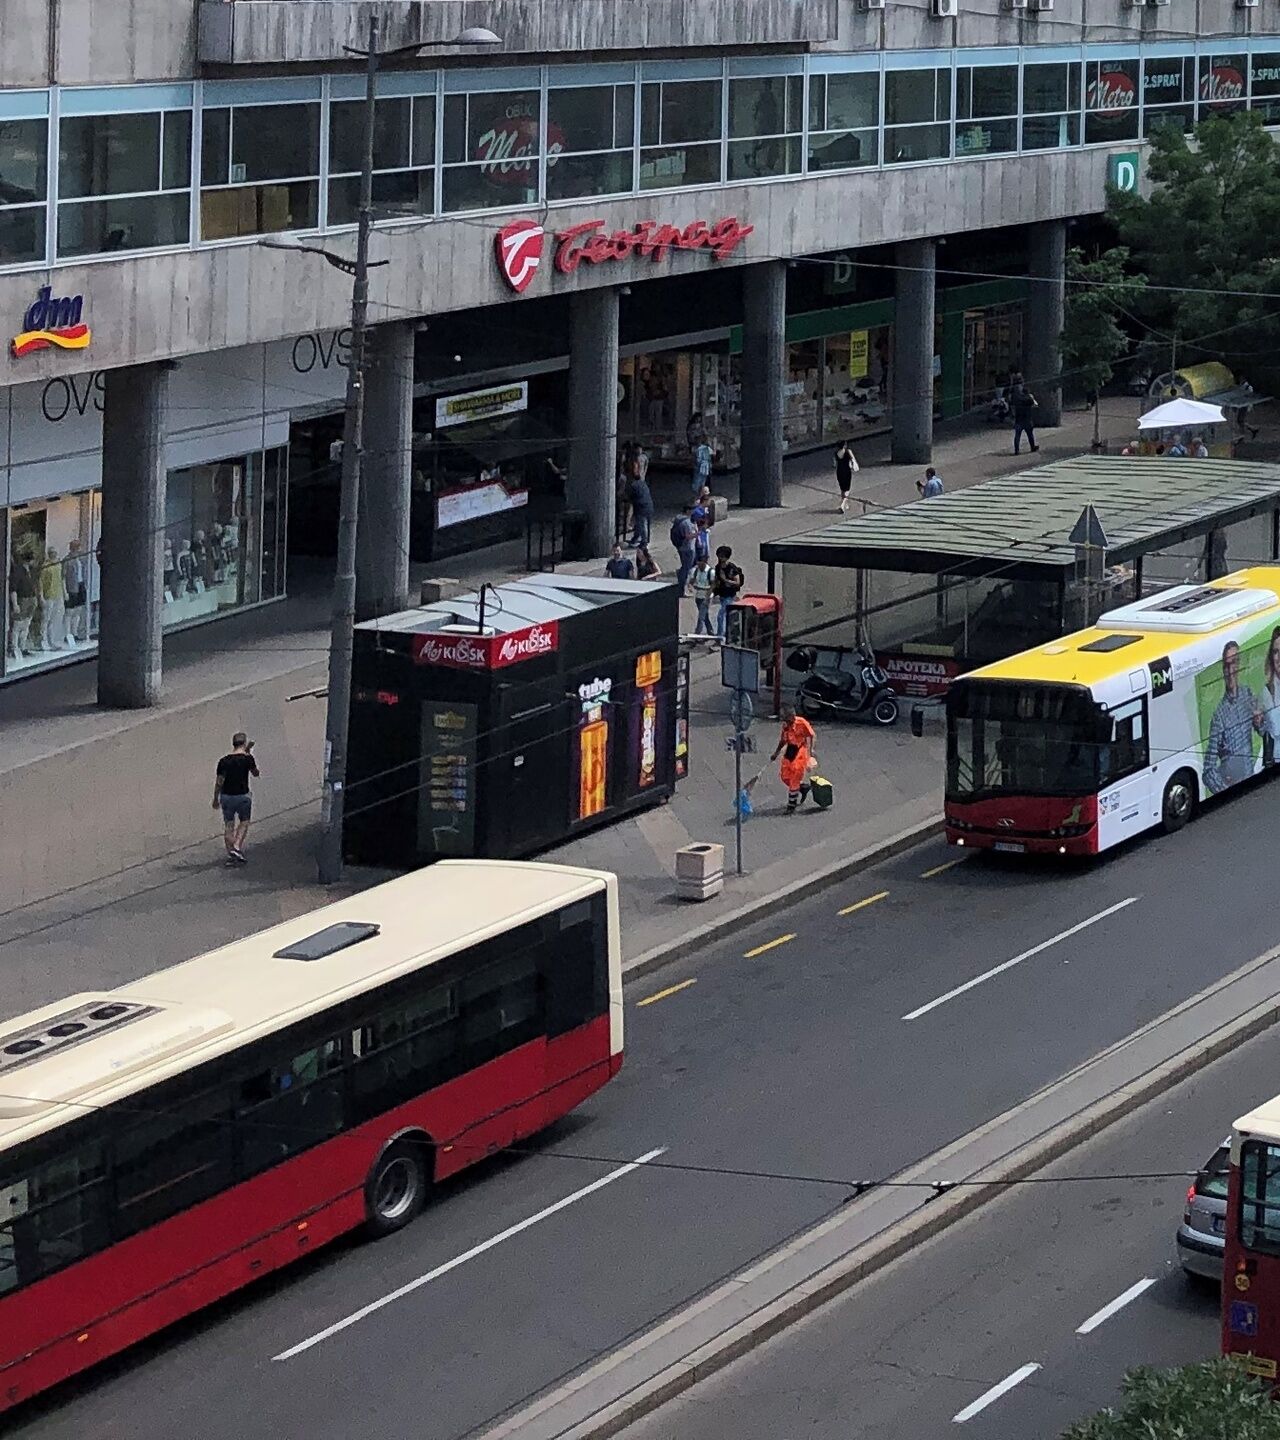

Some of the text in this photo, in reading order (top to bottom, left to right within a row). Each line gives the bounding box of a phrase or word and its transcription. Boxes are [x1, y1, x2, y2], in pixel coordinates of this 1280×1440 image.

[1088, 79, 1134, 111] Metro
[1201, 74, 1242, 101] Metro
[1117, 161, 1135, 192] D
[23, 284, 84, 332] dm
[292, 327, 353, 373] OVS
[420, 639, 486, 663] Moj KIOSK
[498, 627, 552, 660] Moj KIOSK
[886, 659, 946, 675] APOTEKA
[1152, 667, 1173, 689] FAM
